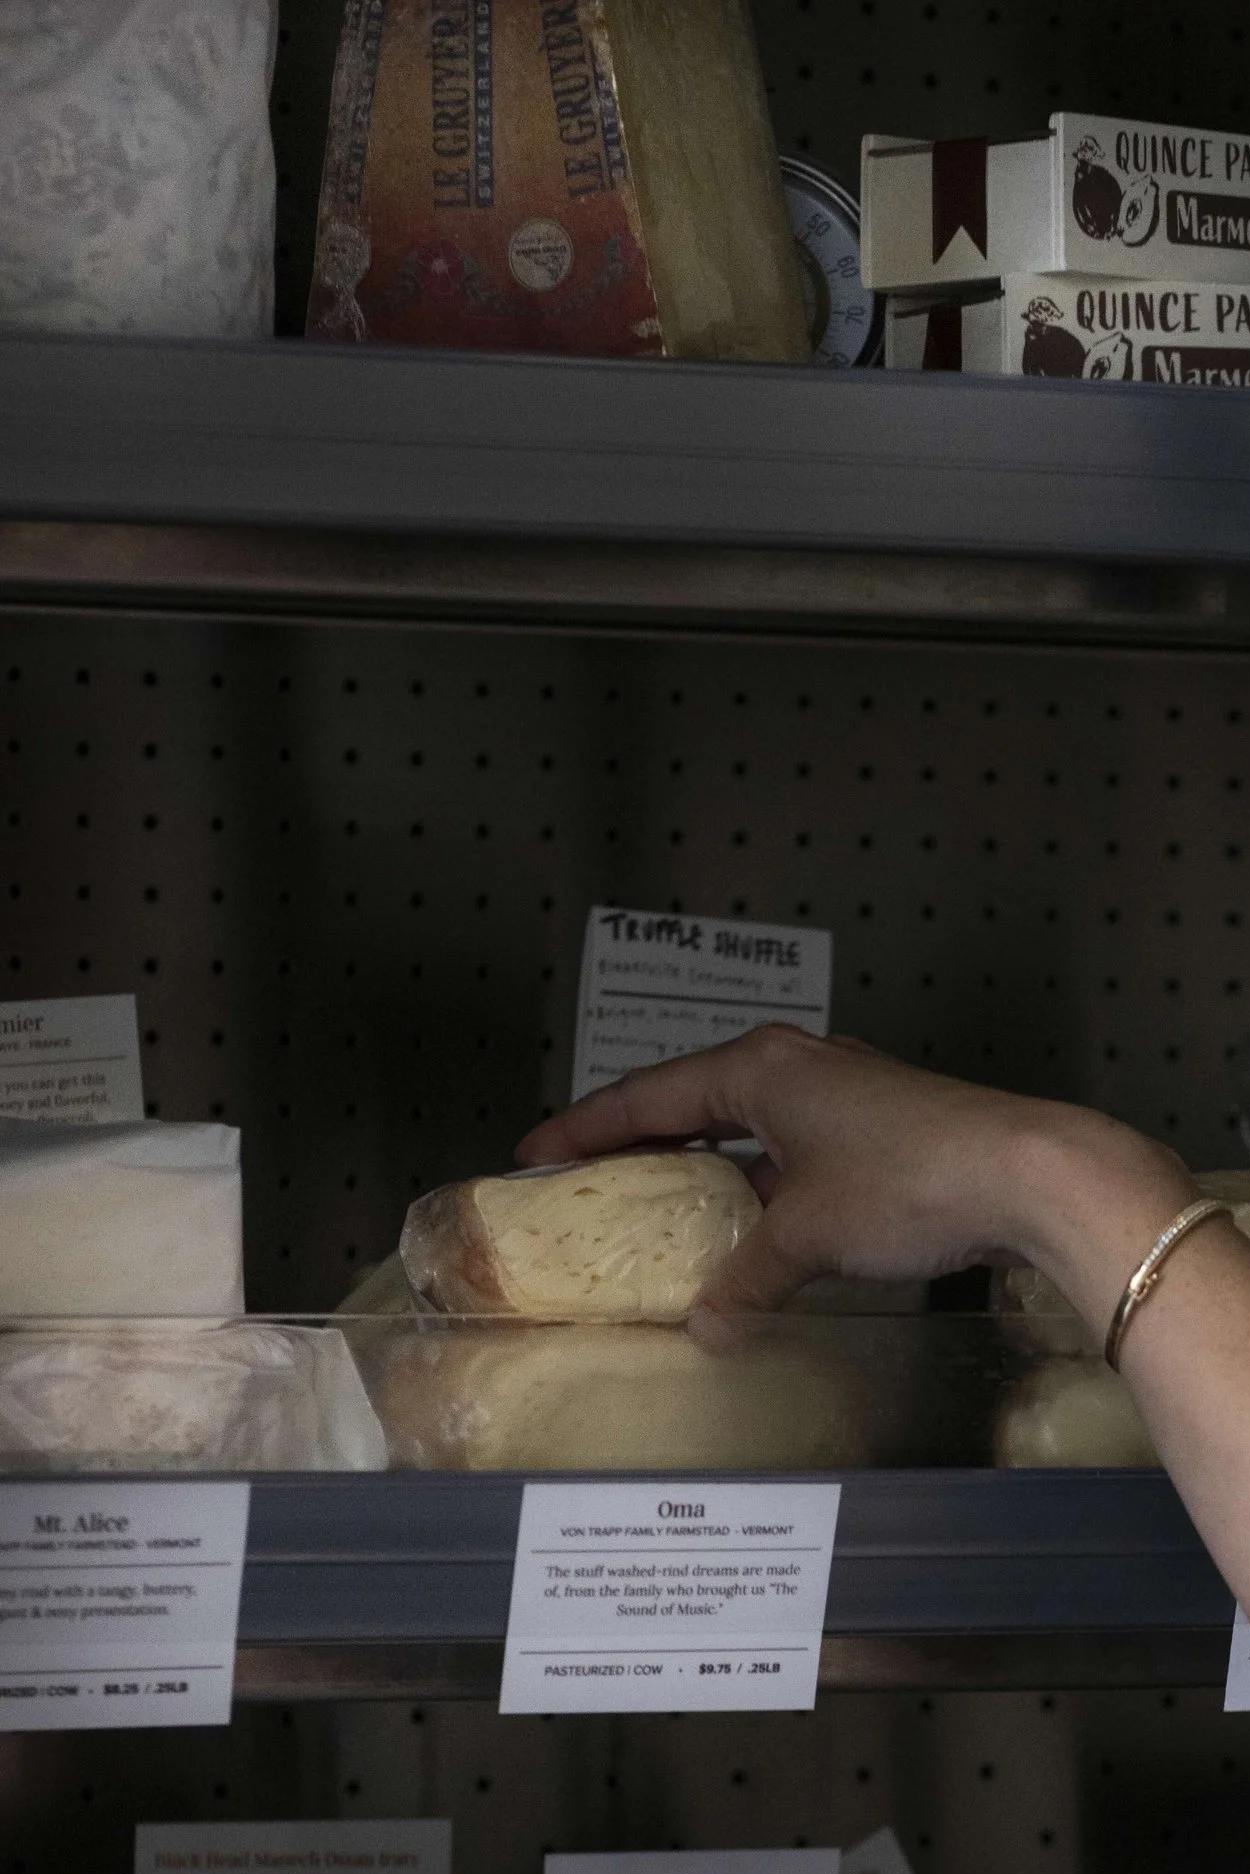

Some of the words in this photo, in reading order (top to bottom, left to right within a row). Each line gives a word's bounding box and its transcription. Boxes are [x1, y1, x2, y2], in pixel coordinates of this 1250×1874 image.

[476, 1, 491, 200] SWITZERLAND
[1115, 130, 1213, 180] QUINCE
[1076, 289, 1202, 334] QUINCE
[658, 1502, 705, 1518] Oma
[561, 1528, 585, 1537] VON
[589, 1527, 622, 1536] TRAPP
[625, 1527, 663, 1536] FAMILY
[666, 1526, 730, 1536] FARMSTEAD
[742, 1526, 794, 1536] VERMONT
[546, 1566, 570, 1578] The
[574, 1565, 604, 1578] stuff
[608, 1565, 689, 1578] washed-rind
[692, 1564, 739, 1576] dreams
[742, 1567, 763, 1576] are
[766, 1564, 800, 1576] made
[544, 1585, 560, 1598] of,
[564, 1585, 596, 1597] from
[599, 1585, 620, 1597] the
[624, 1585, 662, 1600] family
[666, 1584, 694, 1596] who
[697, 1583, 747, 1599] brought
[751, 1586, 765, 1595] us
[770, 1582, 798, 1594] "The
[616, 1604, 657, 1616] Sound
[660, 1603, 675, 1616] of
[677, 1603, 723, 1616] Music."
[545, 1666, 624, 1676] PASTEURIZED
[634, 1665, 663, 1675] COW
[699, 1664, 732, 1675] $9.75
[748, 1663, 781, 1674] .25LB
